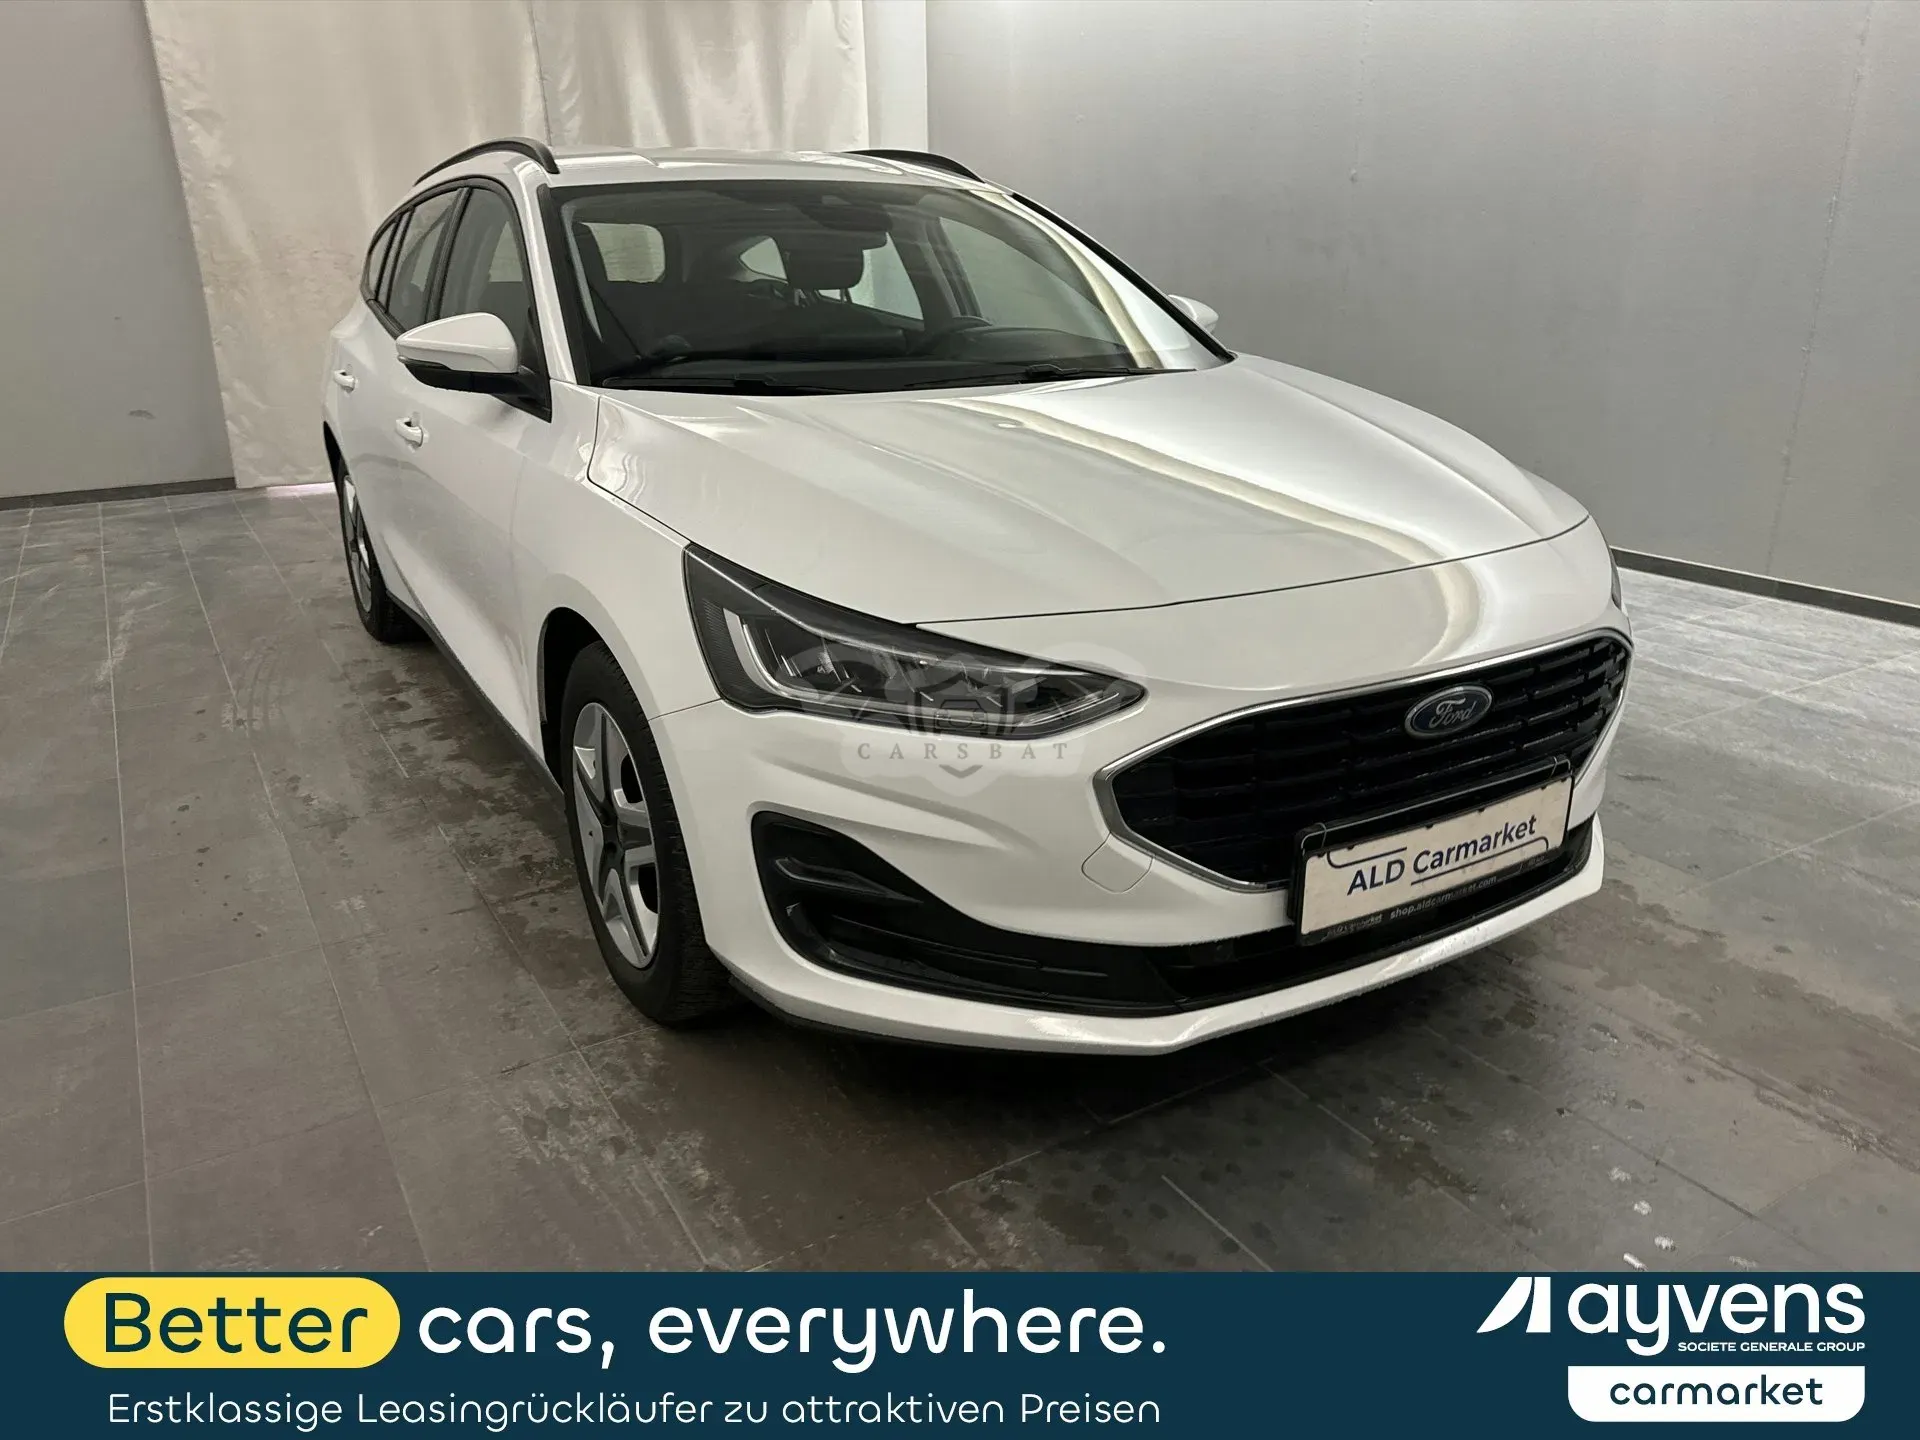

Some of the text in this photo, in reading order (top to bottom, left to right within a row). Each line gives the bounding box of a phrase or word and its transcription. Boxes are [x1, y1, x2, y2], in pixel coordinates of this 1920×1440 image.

[1429, 697, 1477, 729] Ford
[1347, 814, 1537, 895] ALD Carmarket
